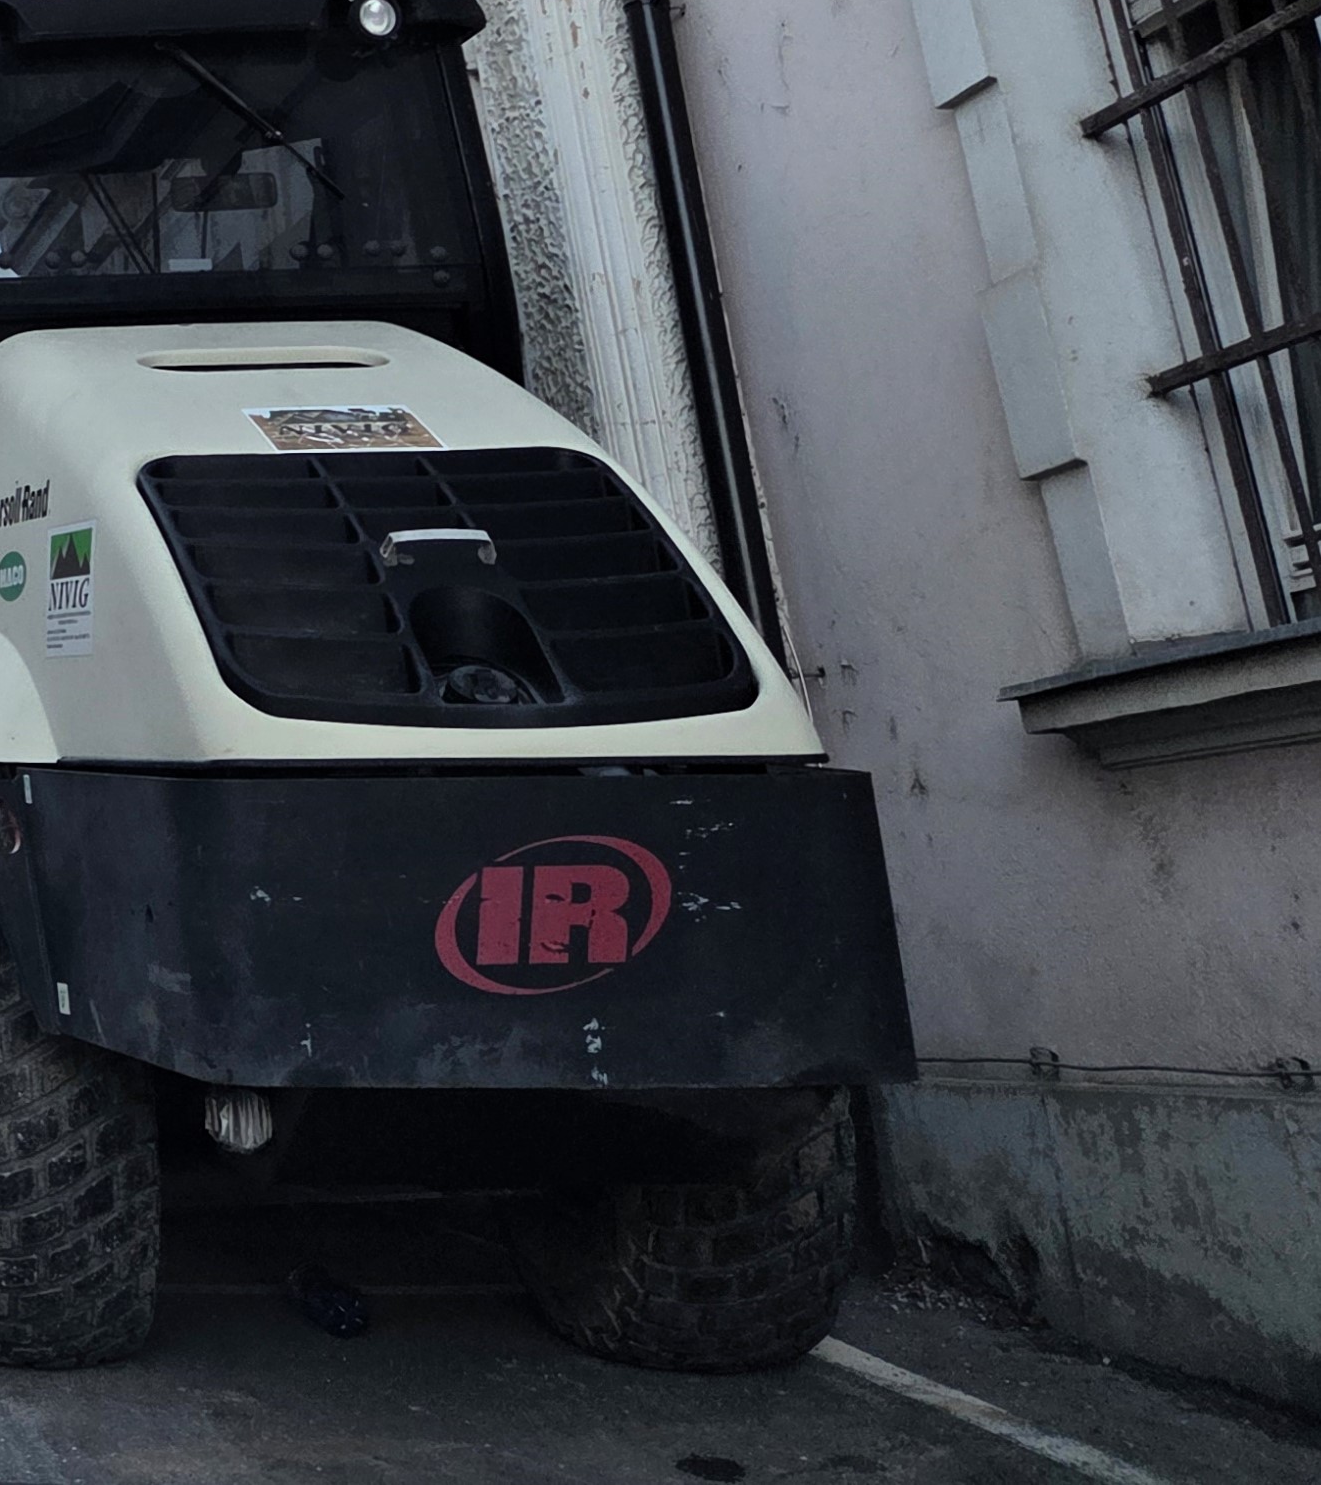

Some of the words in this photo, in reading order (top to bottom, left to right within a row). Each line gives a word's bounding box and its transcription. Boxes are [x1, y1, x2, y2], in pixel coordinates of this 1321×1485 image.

[21, 479, 50, 522] Rand
[48, 577, 90, 612] NIVIG
[476, 865, 630, 965] IR
